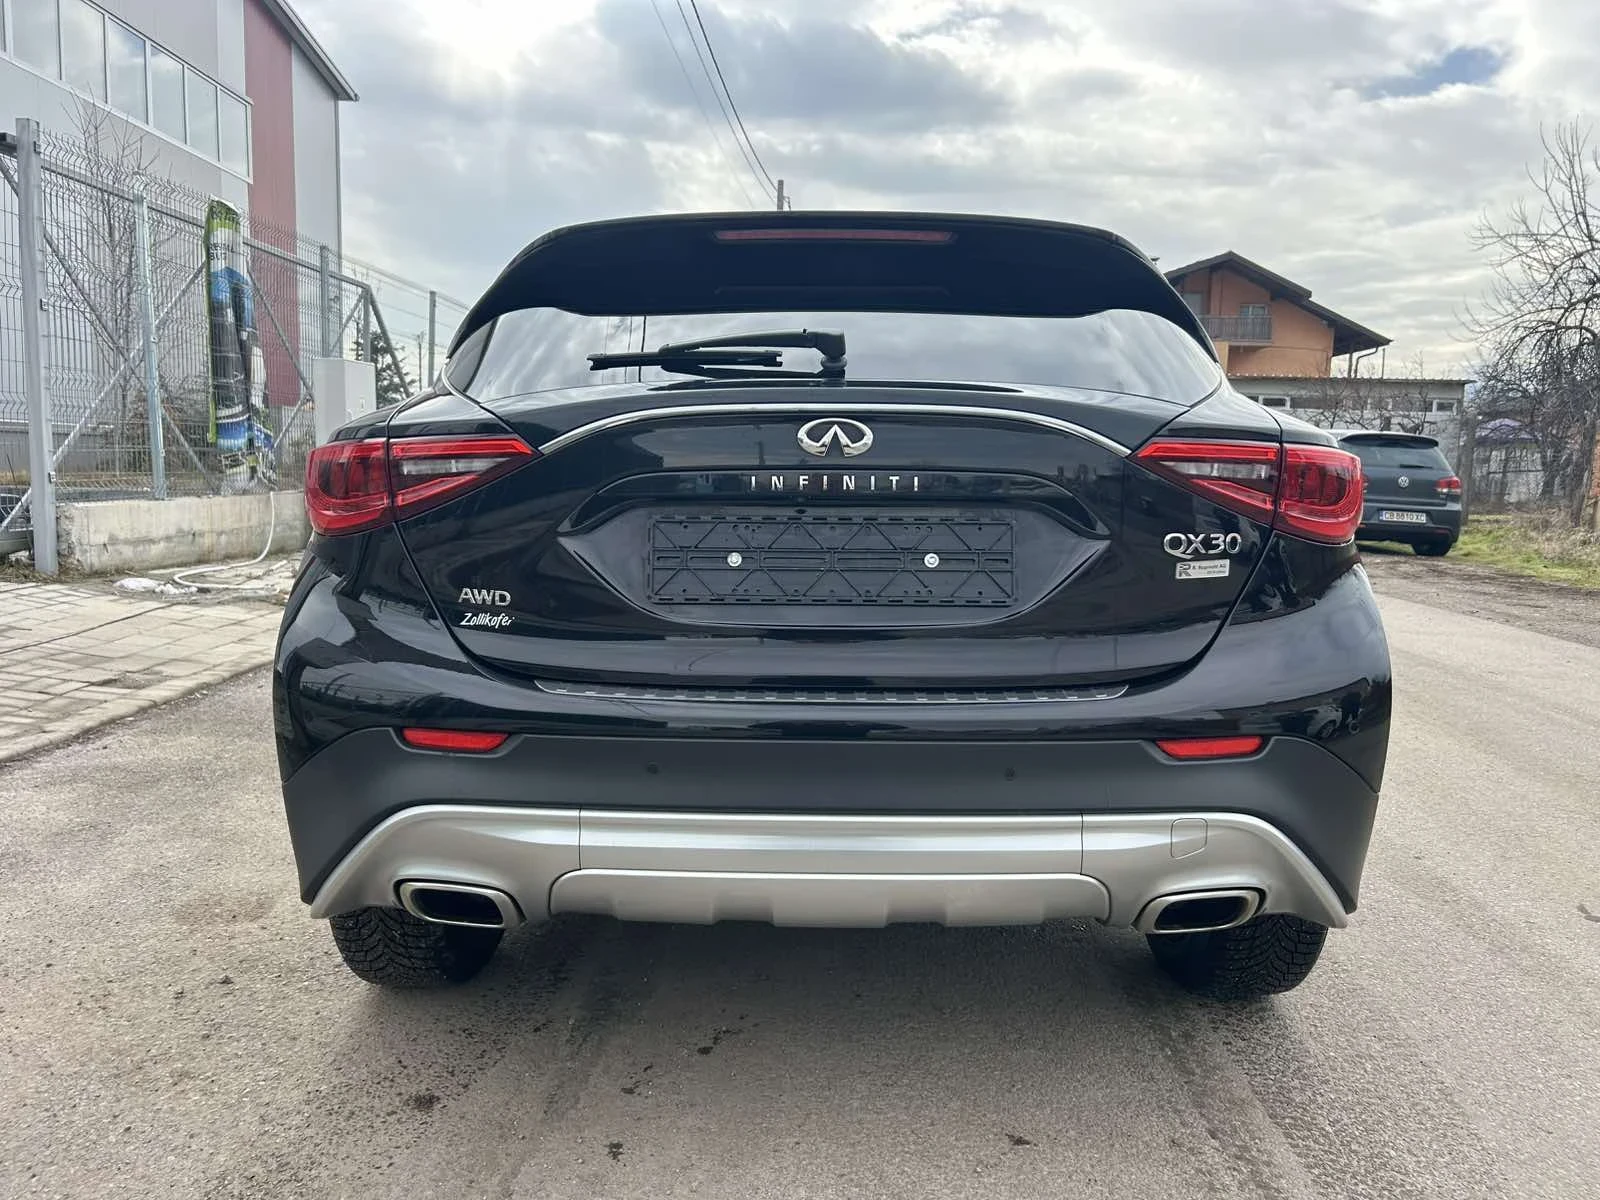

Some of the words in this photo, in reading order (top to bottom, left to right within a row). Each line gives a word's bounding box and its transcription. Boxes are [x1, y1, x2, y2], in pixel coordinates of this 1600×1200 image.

[751, 475, 919, 492] INFINITI
[1163, 532, 1242, 559] QX30
[458, 587, 512, 606] AWD
[460, 612, 515, 629] Zollikofer
